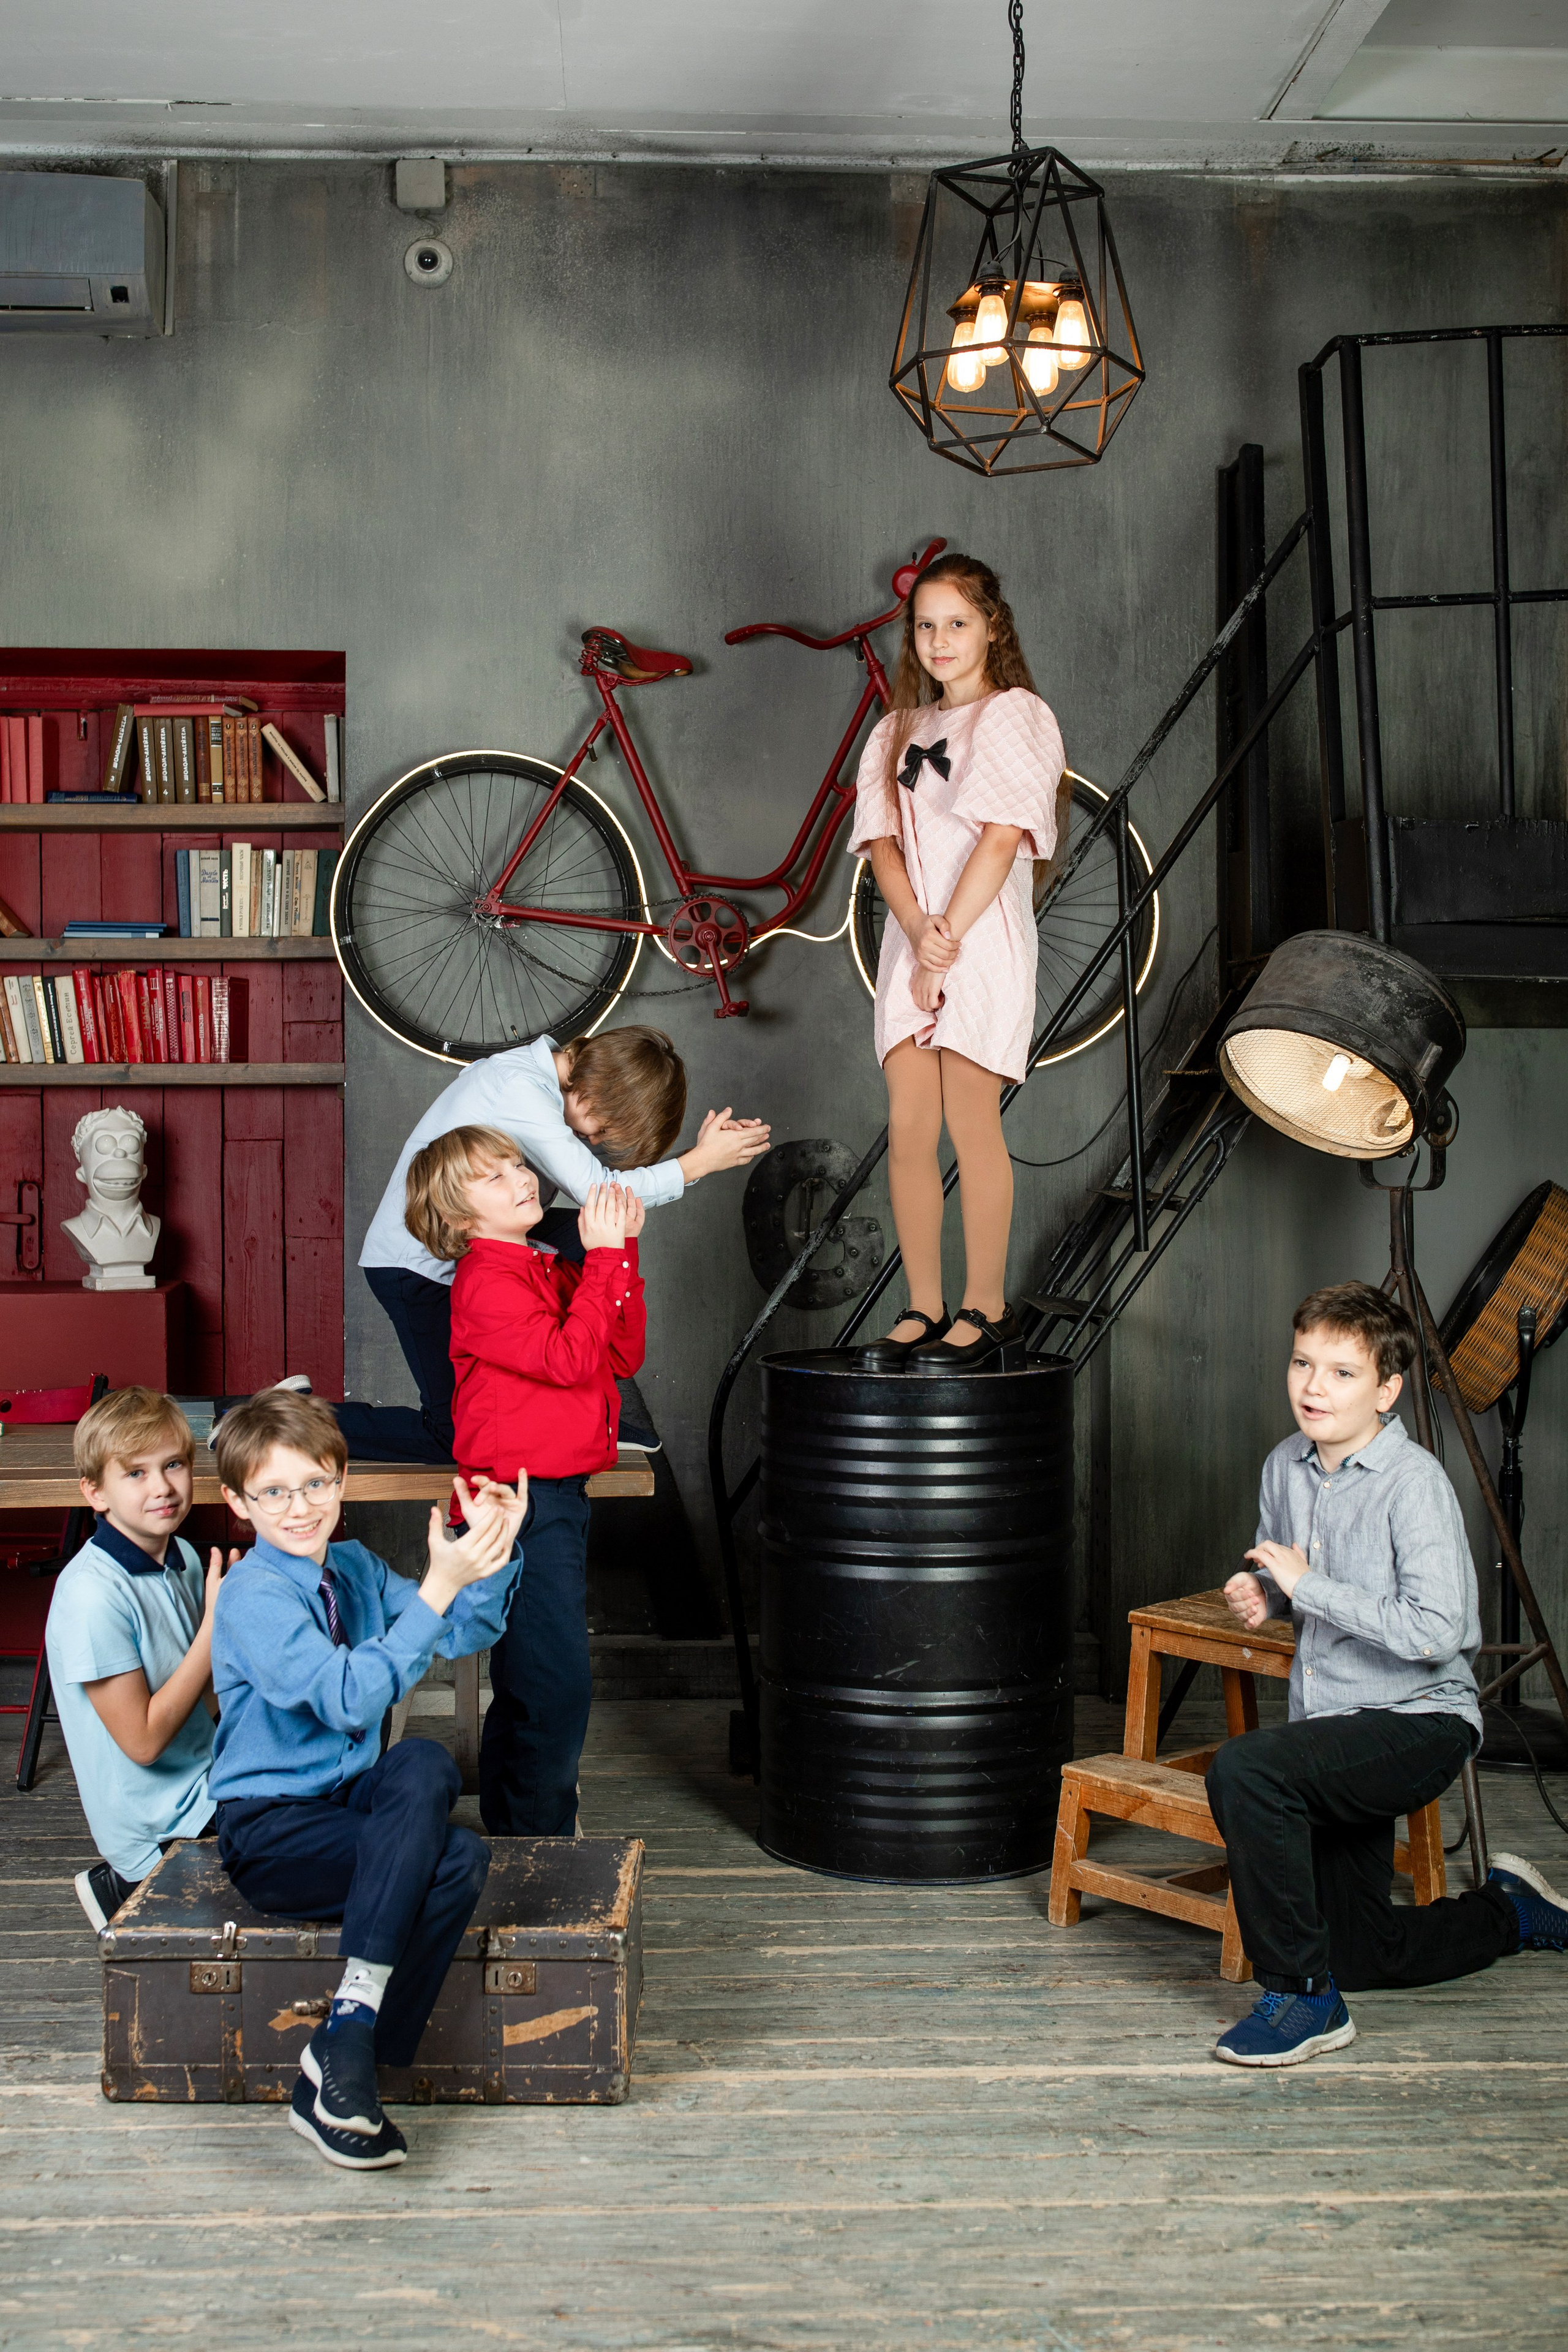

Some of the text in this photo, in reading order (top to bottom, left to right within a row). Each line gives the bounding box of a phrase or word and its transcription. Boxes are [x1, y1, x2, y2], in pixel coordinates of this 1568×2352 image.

[113, 715, 127, 769] ШОЛОМ-АЛЕЙХЕМ
[143, 727, 151, 782] ШОЛОМ-АЛЕЙХЕМ
[64, 992, 77, 1055] Сергей Есенин
[141, 996, 151, 1029] НАБАТ
